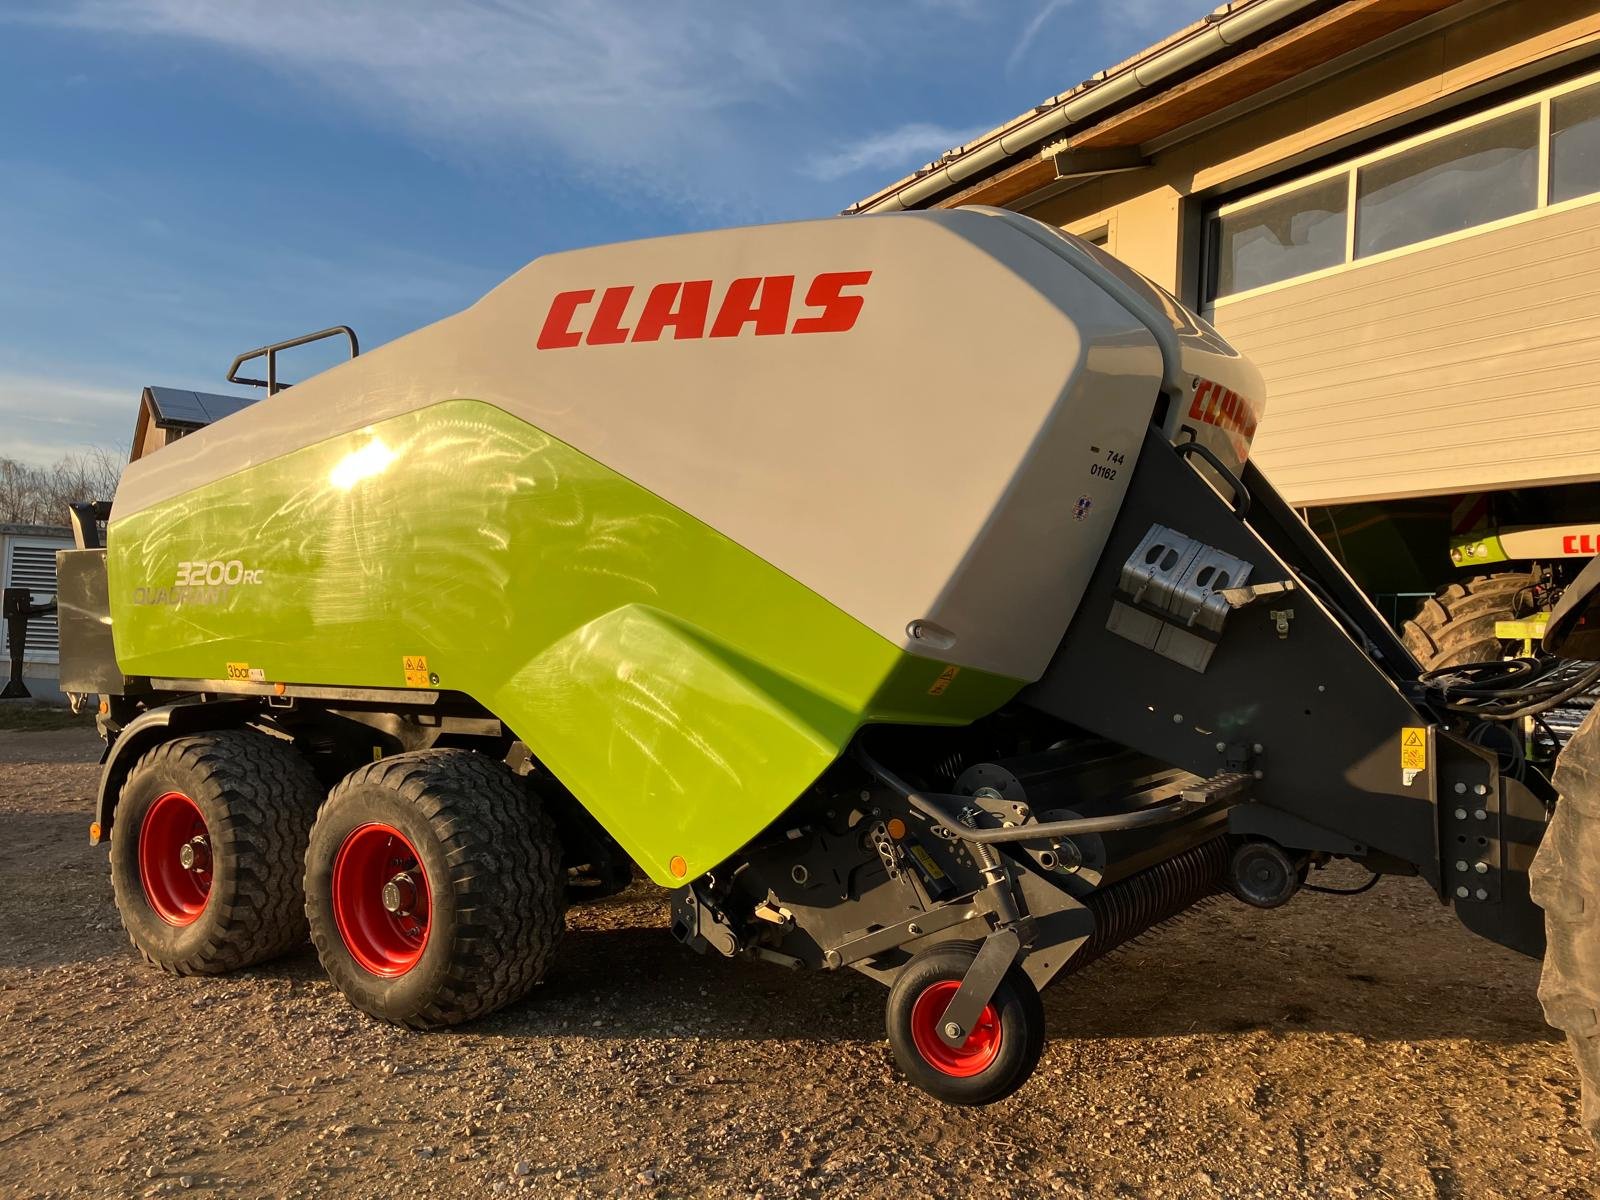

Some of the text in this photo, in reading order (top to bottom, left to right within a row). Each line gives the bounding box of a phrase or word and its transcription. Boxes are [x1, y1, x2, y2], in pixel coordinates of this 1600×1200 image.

[536, 270, 873, 350] CLAAS
[1107, 450, 1125, 465] 744
[1090, 463, 1117, 480] 01162
[1563, 534, 1600, 554] CL
